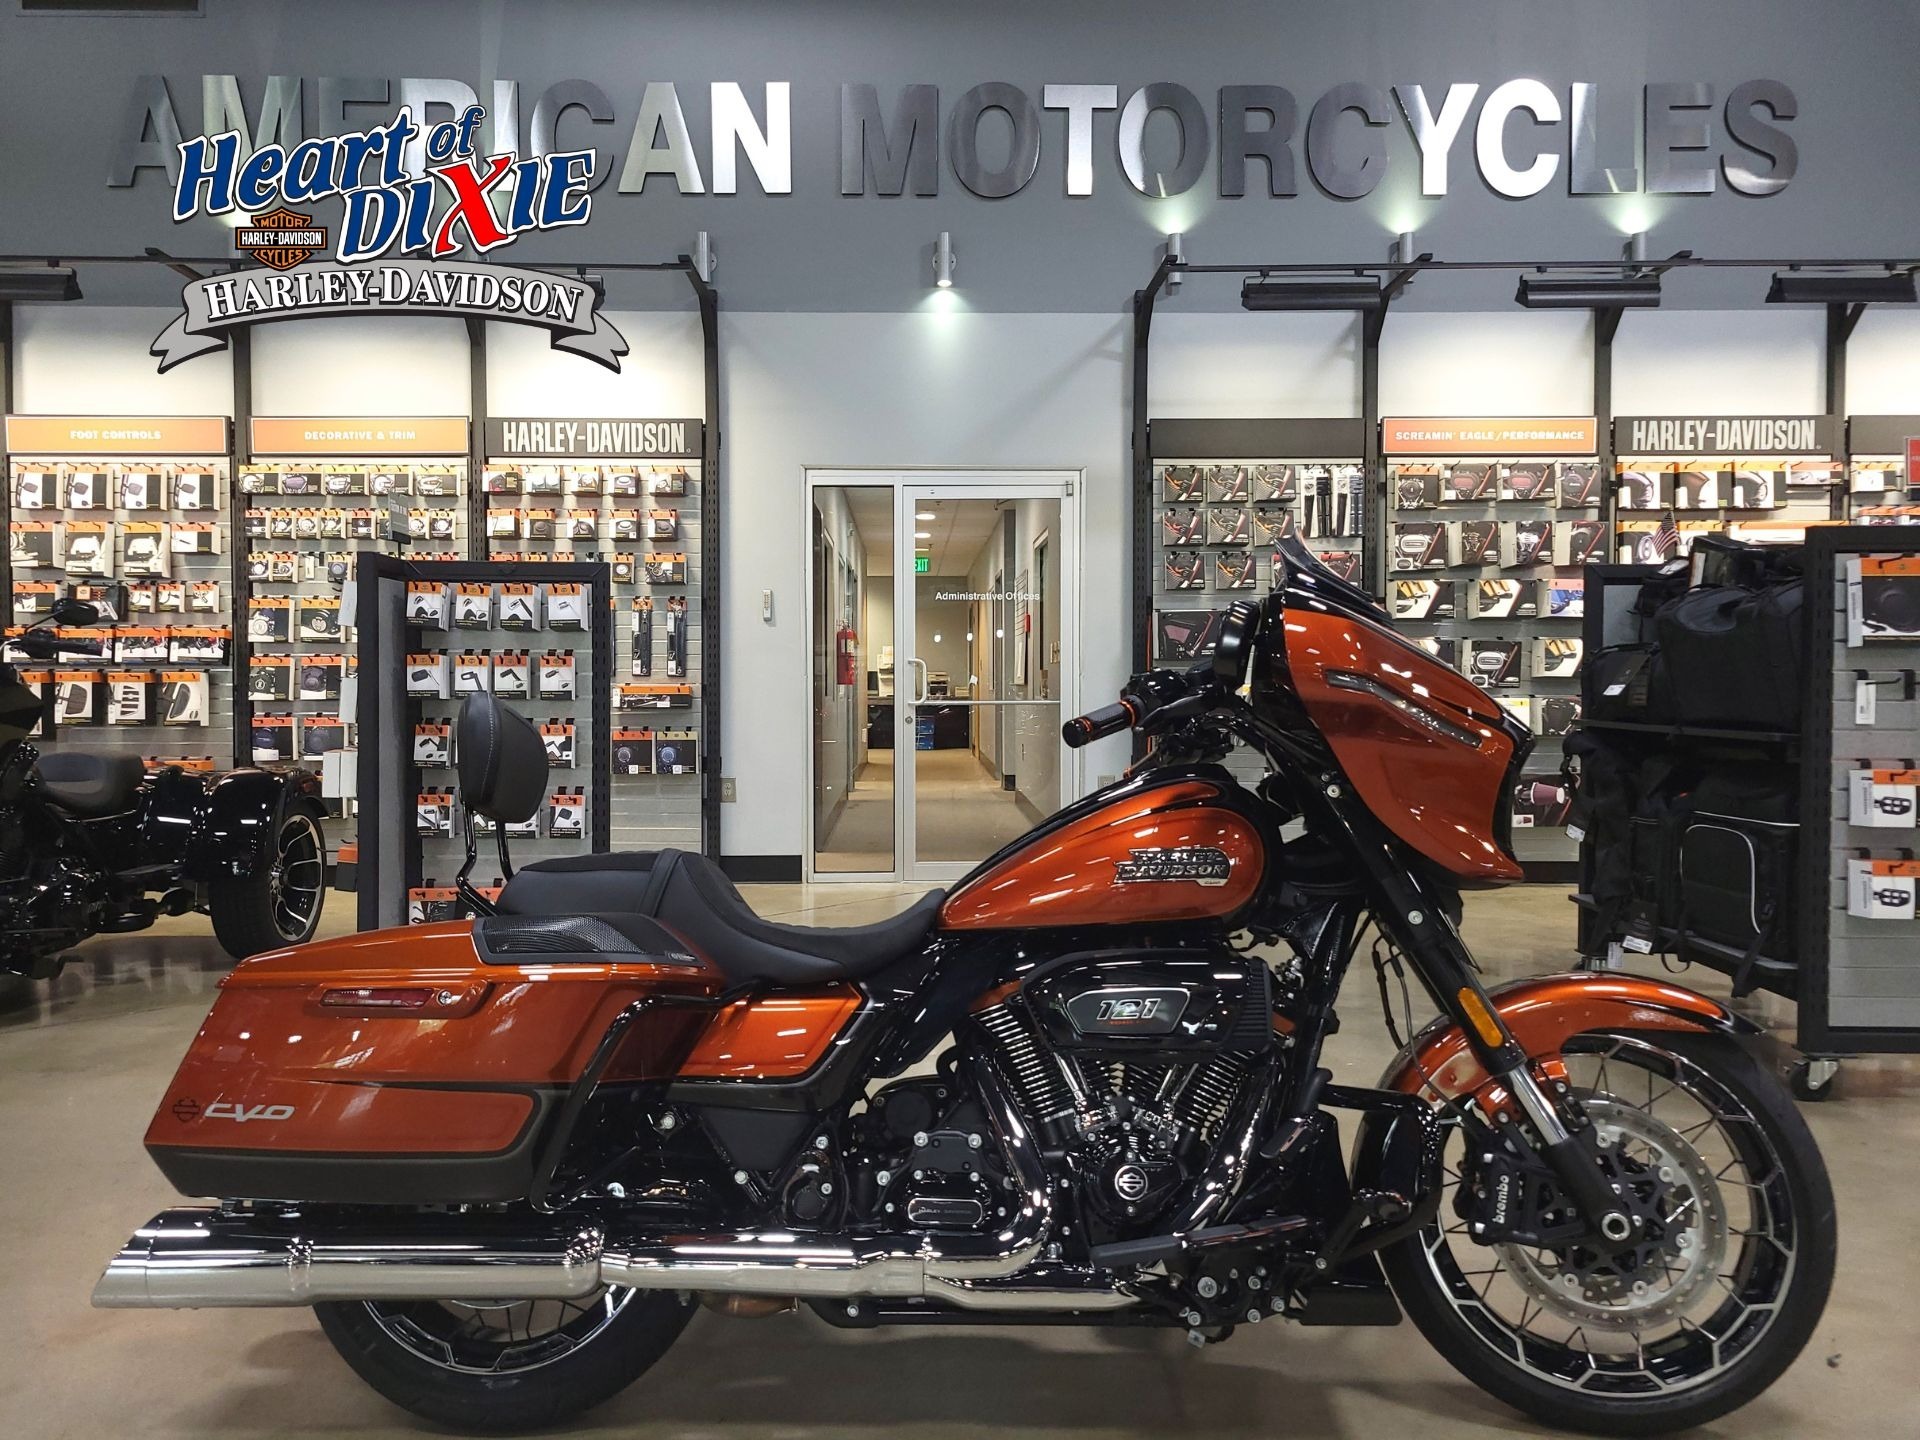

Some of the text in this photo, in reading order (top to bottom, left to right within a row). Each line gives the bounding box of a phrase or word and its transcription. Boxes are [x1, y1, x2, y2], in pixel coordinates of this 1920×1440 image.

[841, 80, 1800, 199] MOTORCYCLES
[69, 430, 161, 440] FOOT CONTROLS
[304, 431, 416, 441] DECORATIVE & TRIM
[502, 421, 686, 453] HARLEY-DAVIDSON
[1632, 419, 1816, 451] HARLEY-DAVIDSON
[915, 559, 928, 571] EXIT
[935, 591, 1040, 601] Administrative Offices
[1121, 864, 1226, 878] DAVIDSON
[1096, 998, 1161, 1020] 121
[204, 1102, 296, 1122] CVO
[1492, 1174, 1510, 1224] brembo
